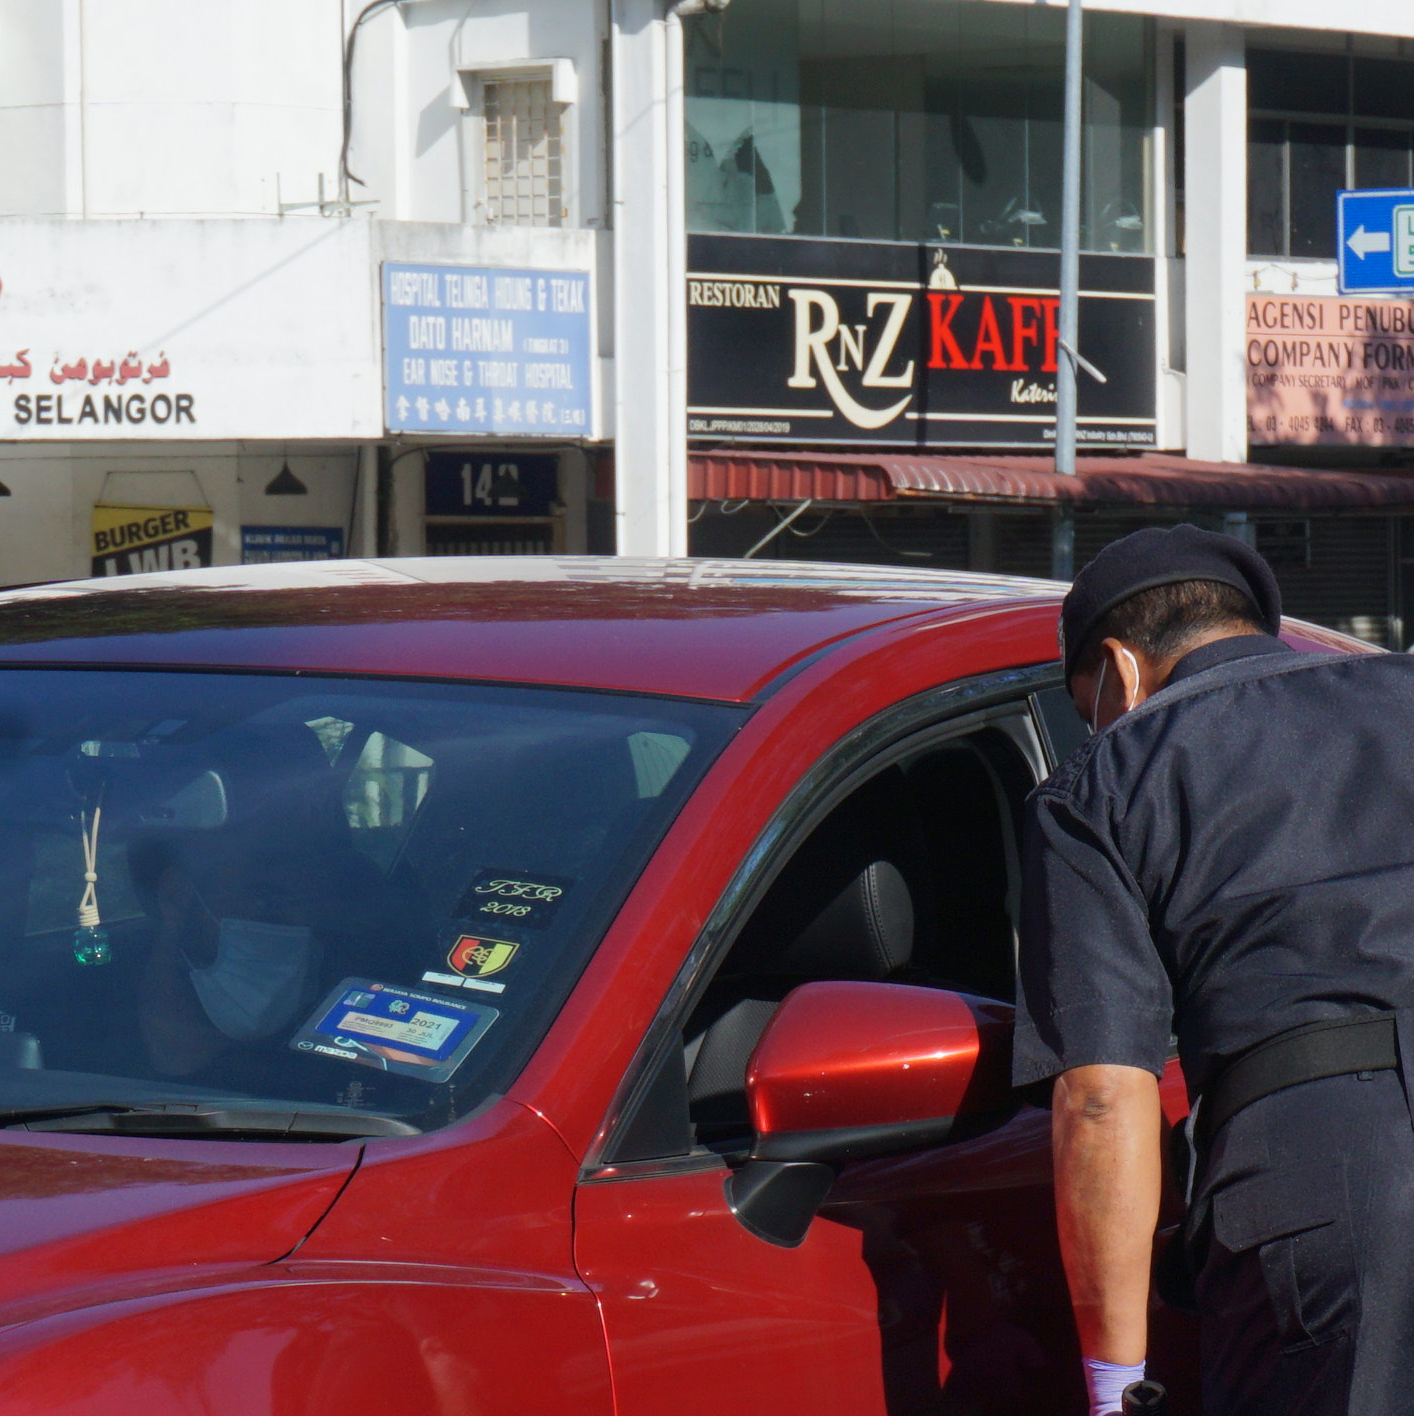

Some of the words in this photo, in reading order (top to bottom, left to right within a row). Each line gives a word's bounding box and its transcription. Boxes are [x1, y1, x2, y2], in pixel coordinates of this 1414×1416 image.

[391, 271, 441, 307] HOSPITAL
[445, 274, 489, 310] TELINGA
[494, 276, 532, 311] HIDUNG
[538, 278, 547, 312] &
[550, 279, 585, 313] TEKAK
[689, 282, 781, 309] RESTORAN
[1247, 301, 1324, 330] AGENSI
[409, 315, 445, 350] DATO
[452, 317, 513, 352] HARNAM
[1248, 339, 1354, 369] COMPANY
[403, 358, 425, 385] EAR
[430, 359, 459, 386] NOSE
[463, 360, 473, 387] &
[478, 361, 518, 388] THROAT
[525, 363, 574, 389] HOSPITAL
[1299, 375, 1347, 389] SECRETARY
[1011, 378, 1059, 405] Kateri
[14, 393, 196, 425] SELANGOR
[1345, 416, 1363, 433] FAX
[94, 510, 191, 553] BURGER
[480, 902, 531, 917] 2018
[411, 1017, 442, 1031] 2021
[418, 1030, 434, 1039] JUL
[314, 1045, 358, 1060] mazda
